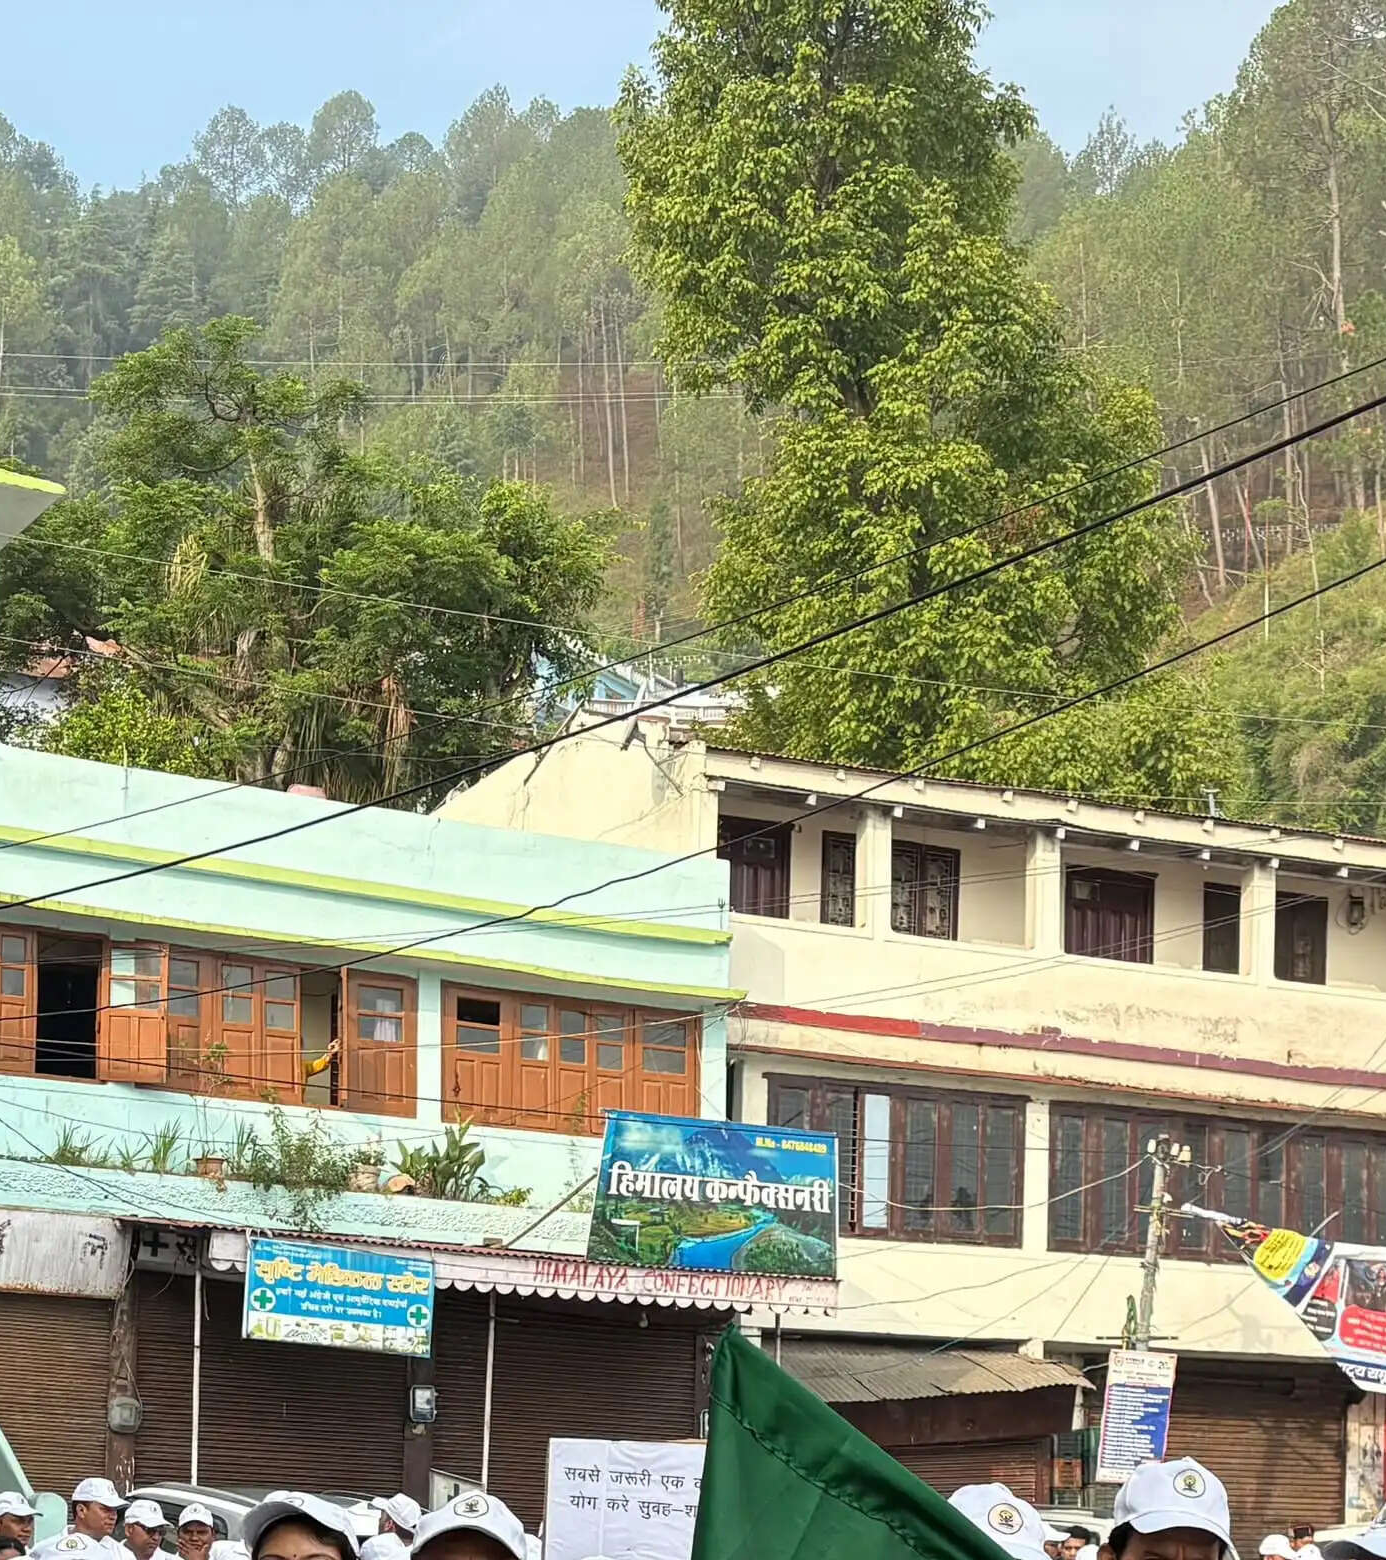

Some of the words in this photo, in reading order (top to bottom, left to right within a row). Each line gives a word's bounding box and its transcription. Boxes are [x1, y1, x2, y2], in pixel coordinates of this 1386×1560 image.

[607, 1160, 701, 1203] हिमालय
[386, 1271, 432, 1296] स्टोर
[533, 1260, 629, 1291] HIMALAYA
[643, 1268, 787, 1301] CONFECTIONARY
[608, 1468, 652, 1489] जरूरी
[660, 1474, 686, 1492] एक
[569, 1490, 599, 1511] योग
